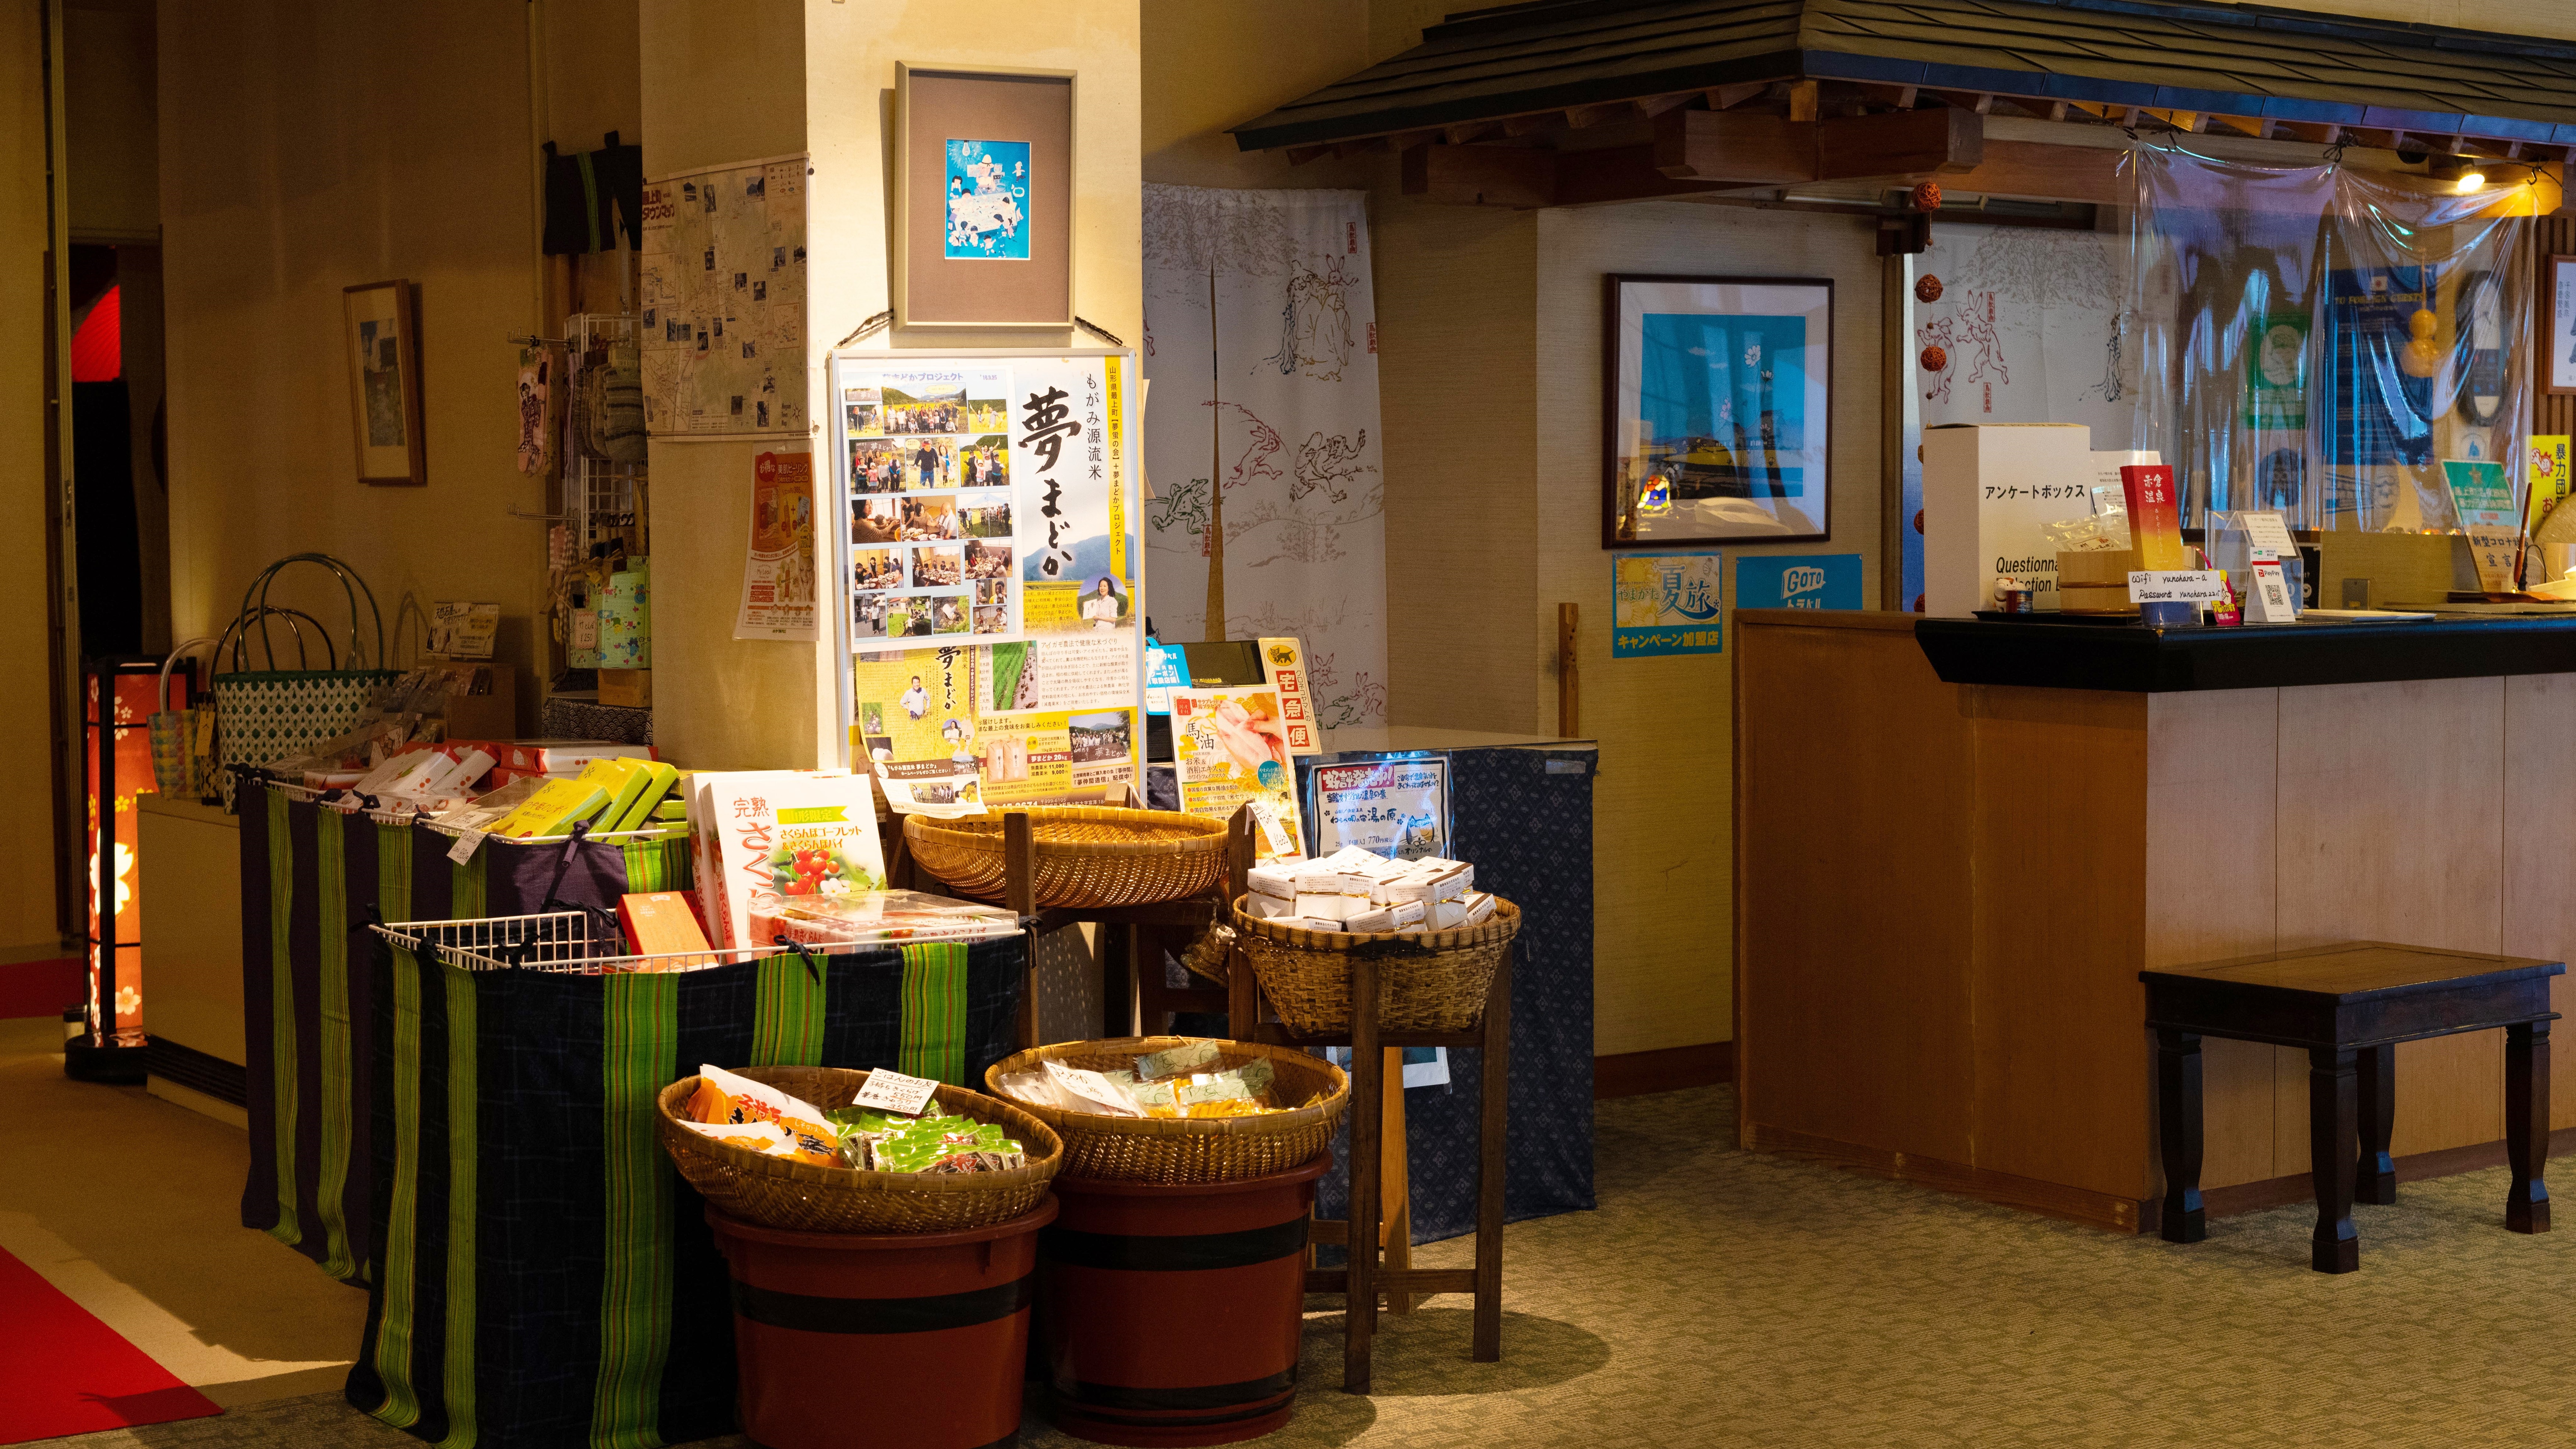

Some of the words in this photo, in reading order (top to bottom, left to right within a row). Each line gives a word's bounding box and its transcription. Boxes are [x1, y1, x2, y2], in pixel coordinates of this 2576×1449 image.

[1086, 373, 1102, 480] もがみ源流米
[1018, 386, 1082, 576] 夢まどか
[2143, 473, 2163, 488] 赤倉
[2556, 443, 2566, 504] 暴力団
[1985, 484, 2085, 499] アンケートボックス
[2144, 489, 2165, 503] 温泉
[2132, 573, 2151, 584] Wifi
[1618, 587, 1660, 602] やまがた
[1041, 638, 1118, 648] アイガモ農法で健康な米づくり
[1618, 631, 1719, 649] キャンペーン加盟店
[1295, 669, 1311, 722] クロネコヤマトの
[1279, 672, 1308, 745] 宅急便
[1187, 722, 1214, 750] 馬油
[1094, 747, 1123, 759] 夢まどか
[1186, 757, 1200, 765] お米
[1191, 784, 1238, 793] 国産の良質な馬油を配合
[733, 796, 770, 818] 完熟
[788, 808, 833, 823] 山形限定
[779, 825, 862, 839] さくらんぼゴーフレット
[1274, 832, 1288, 851] ¥660
[874, 1071, 934, 1089] ごはんのお友
[893, 1092, 923, 1101] 550円
[737, 1093, 782, 1125] 子持ち
[888, 1103, 918, 1112] 350円
